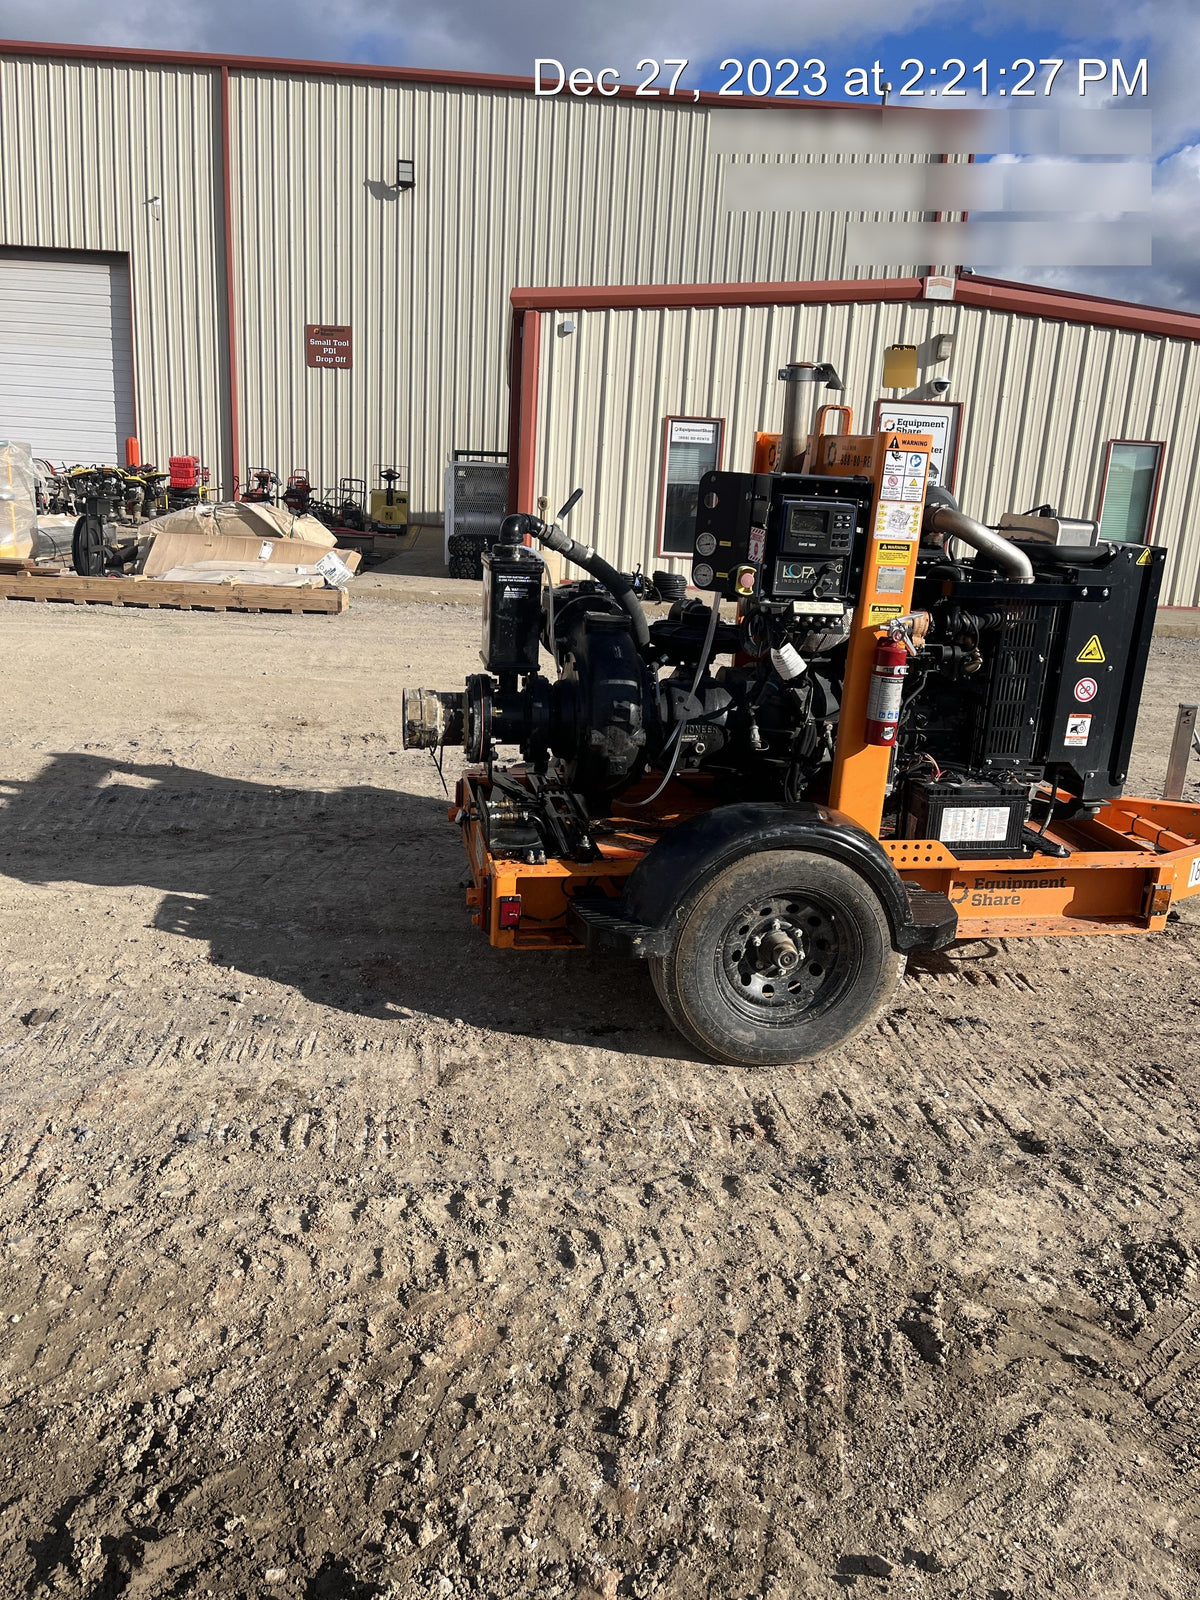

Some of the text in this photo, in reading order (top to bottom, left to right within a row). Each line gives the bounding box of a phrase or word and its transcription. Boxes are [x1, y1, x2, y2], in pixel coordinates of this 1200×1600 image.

[897, 418, 945, 428] Equipment
[782, 564, 818, 579] LOFA
[685, 724, 718, 734] IONEER
[973, 877, 1068, 893] Equipment
[971, 893, 1021, 906] Share
